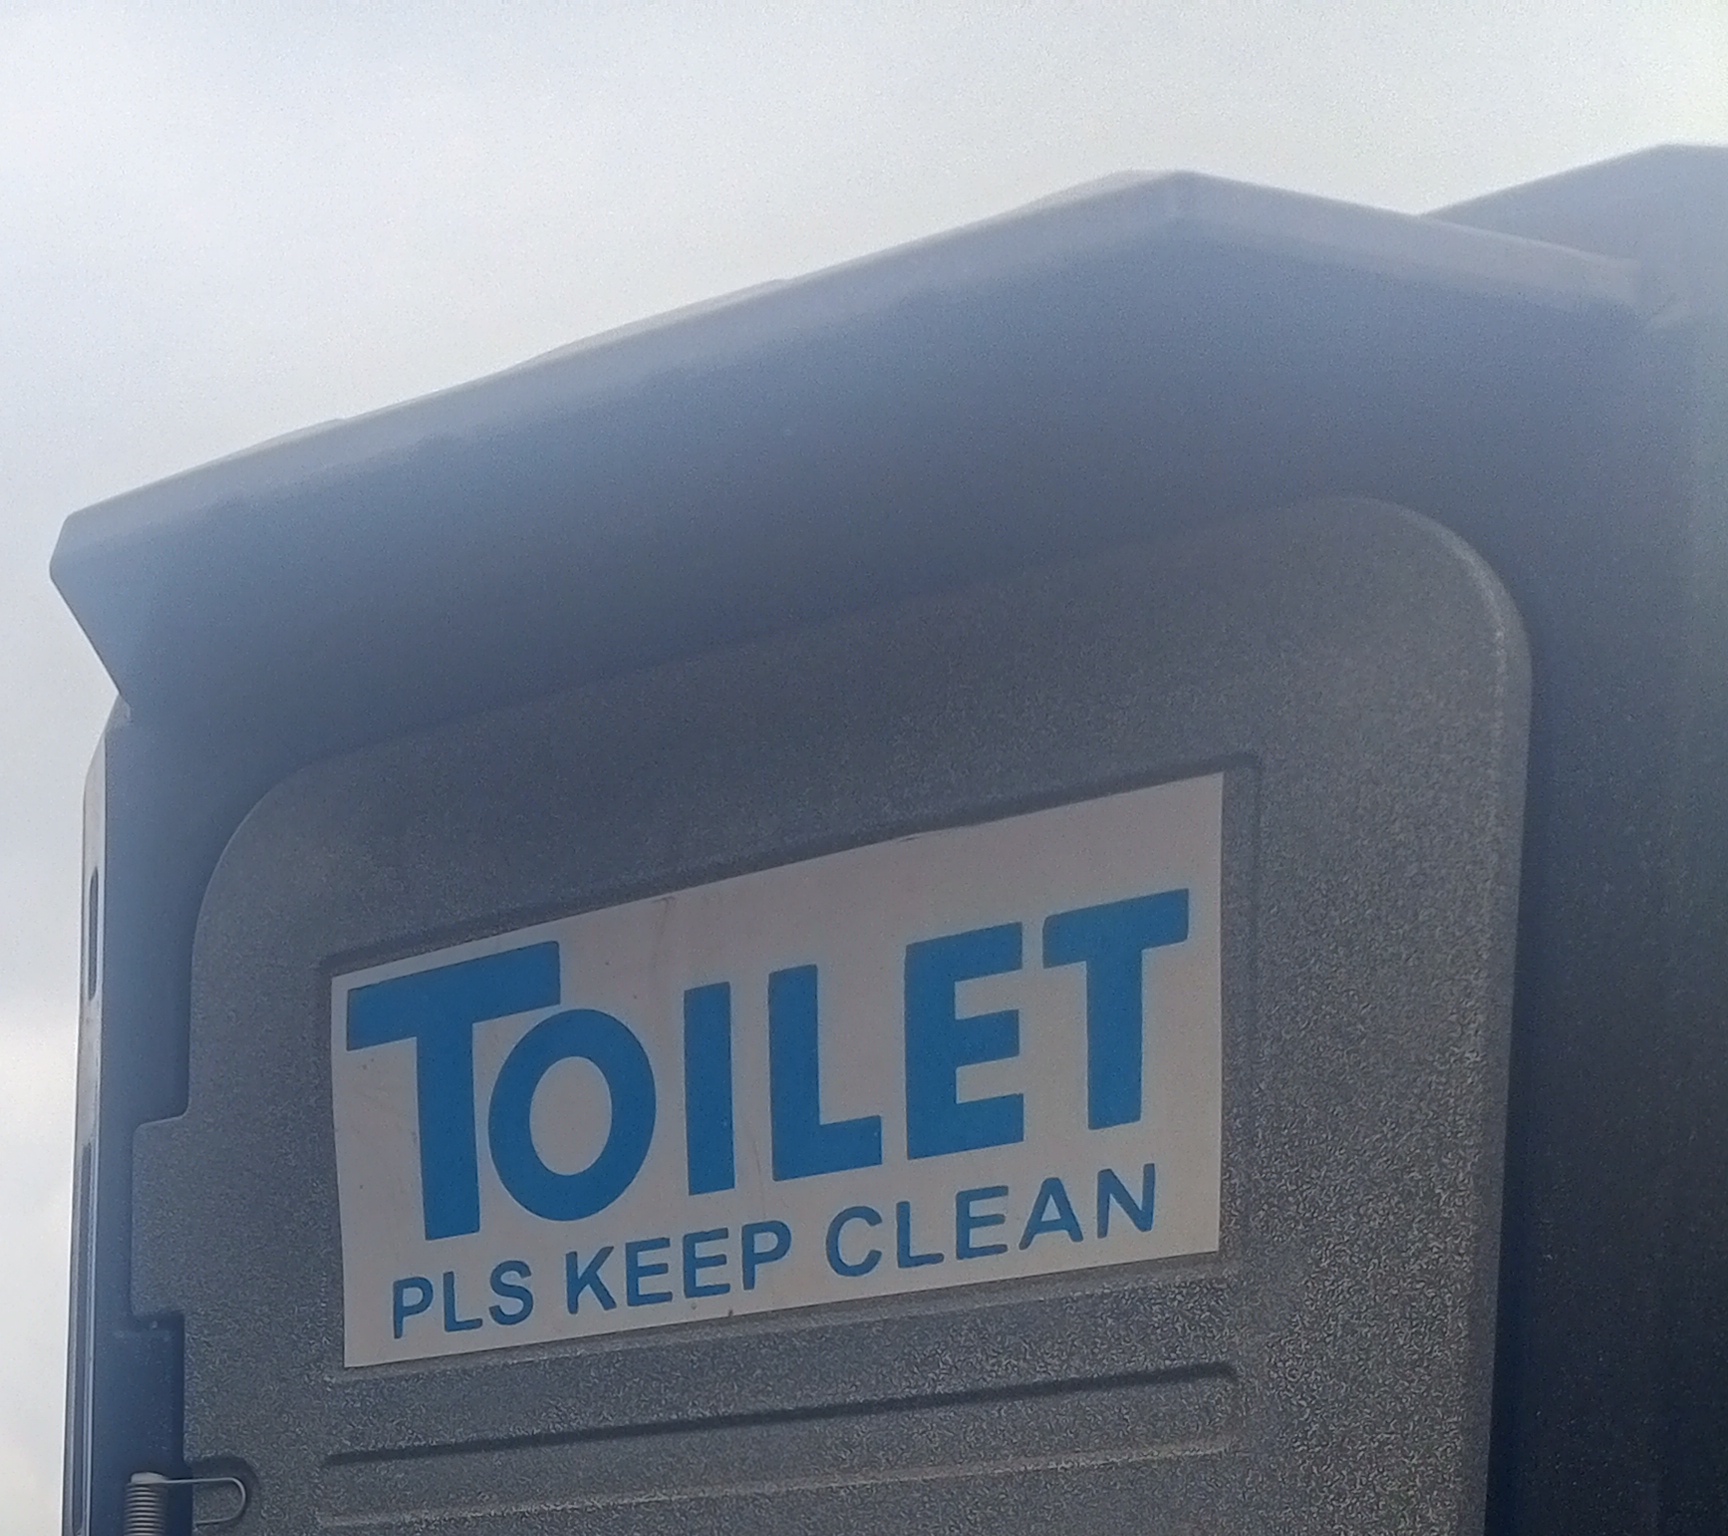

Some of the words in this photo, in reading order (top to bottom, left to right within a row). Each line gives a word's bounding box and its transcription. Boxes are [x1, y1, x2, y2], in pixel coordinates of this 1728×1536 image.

[345, 888, 1190, 1242] TOILET
[393, 1260, 535, 1340] PLS
[565, 1219, 793, 1316] KEEP
[825, 1162, 1158, 1278] CLEAN
